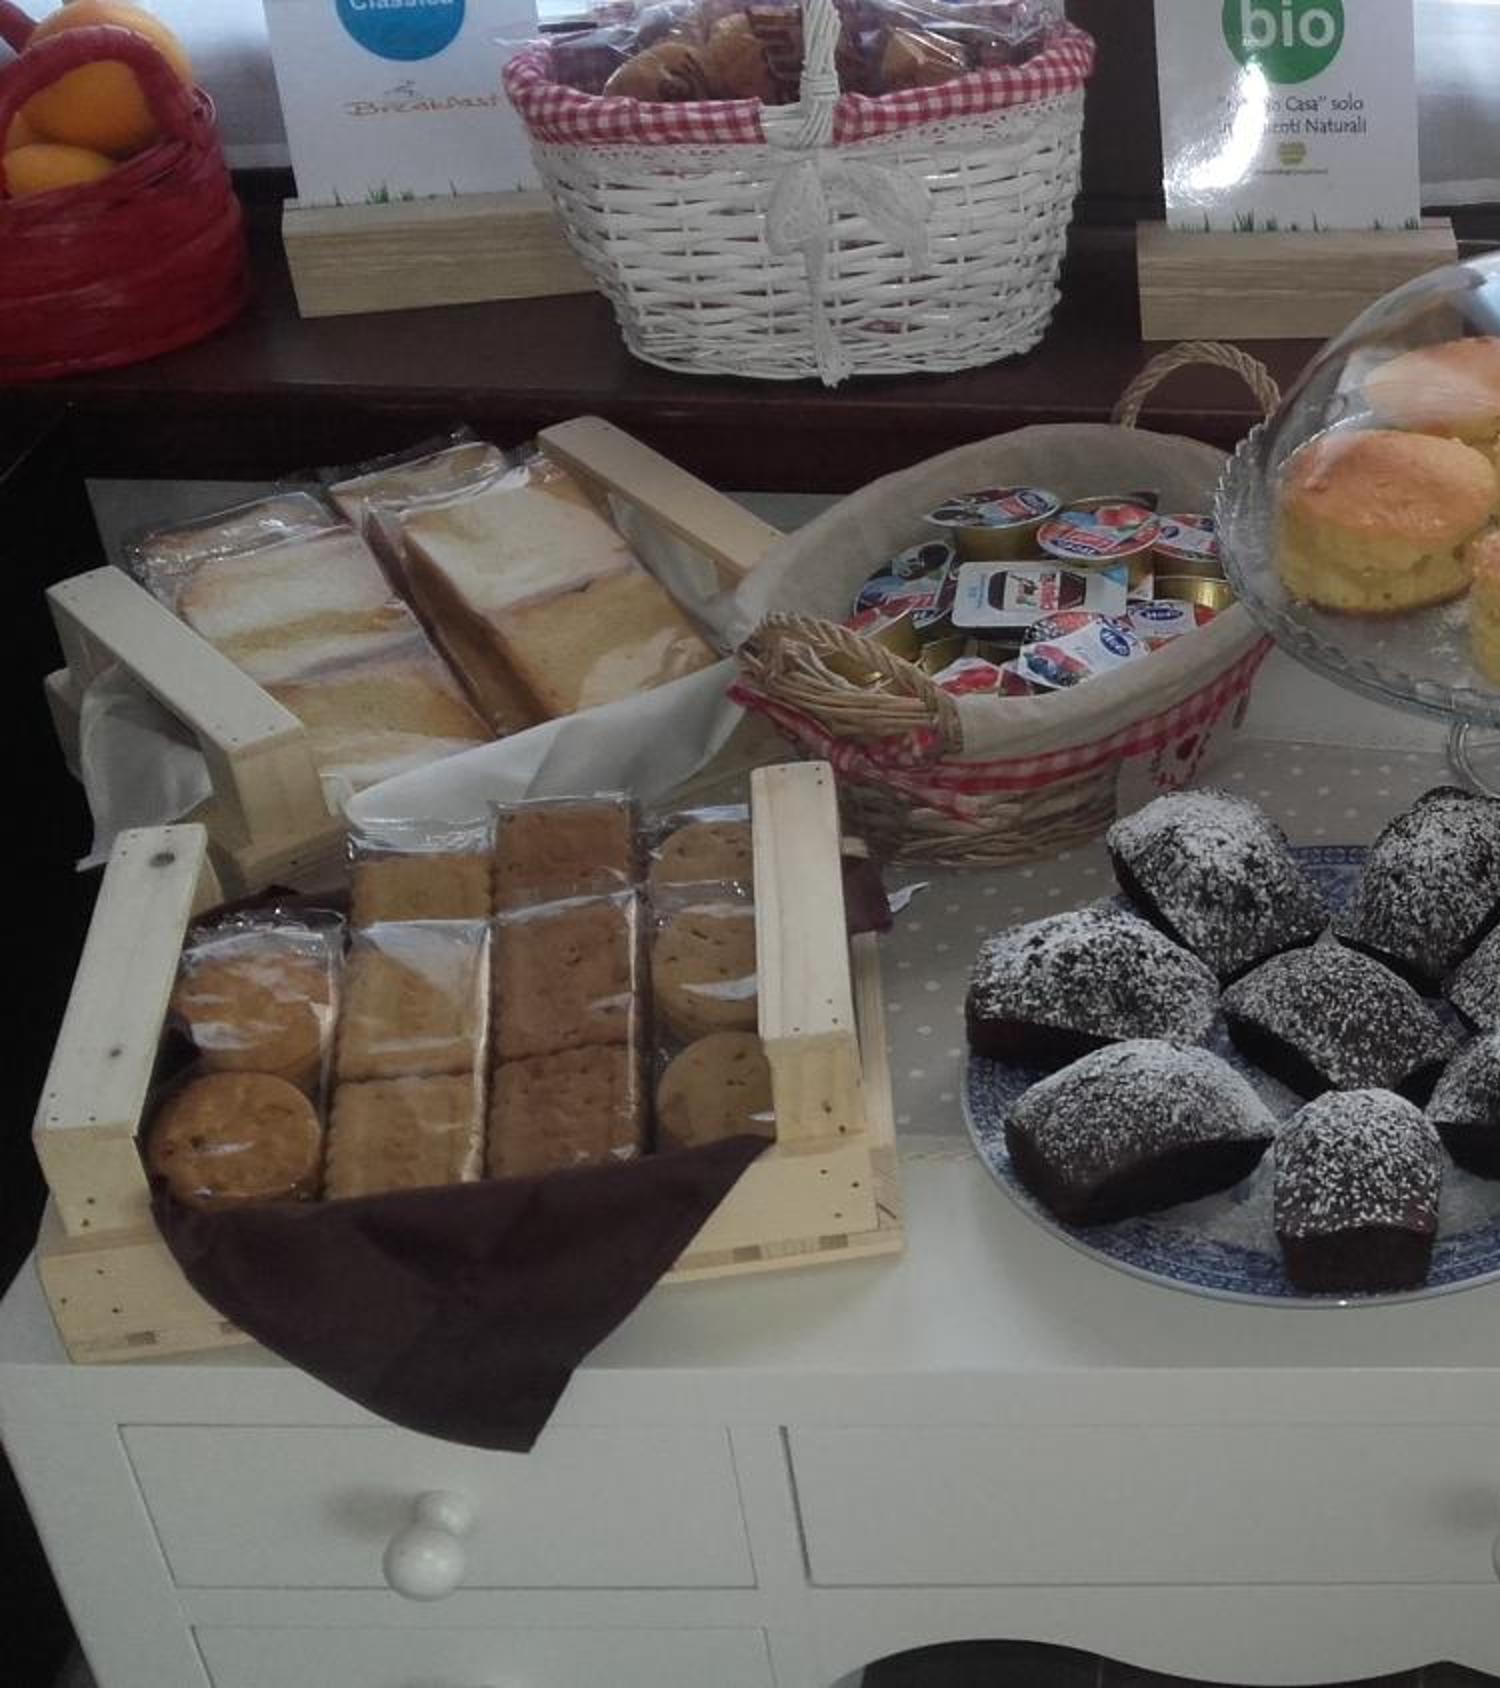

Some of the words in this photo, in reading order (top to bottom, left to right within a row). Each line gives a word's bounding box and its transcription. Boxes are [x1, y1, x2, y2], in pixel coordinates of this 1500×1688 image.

[1240, 0, 1336, 48] bio
[1331, 93, 1364, 111] solo
[1305, 116, 1367, 134] Naturali
